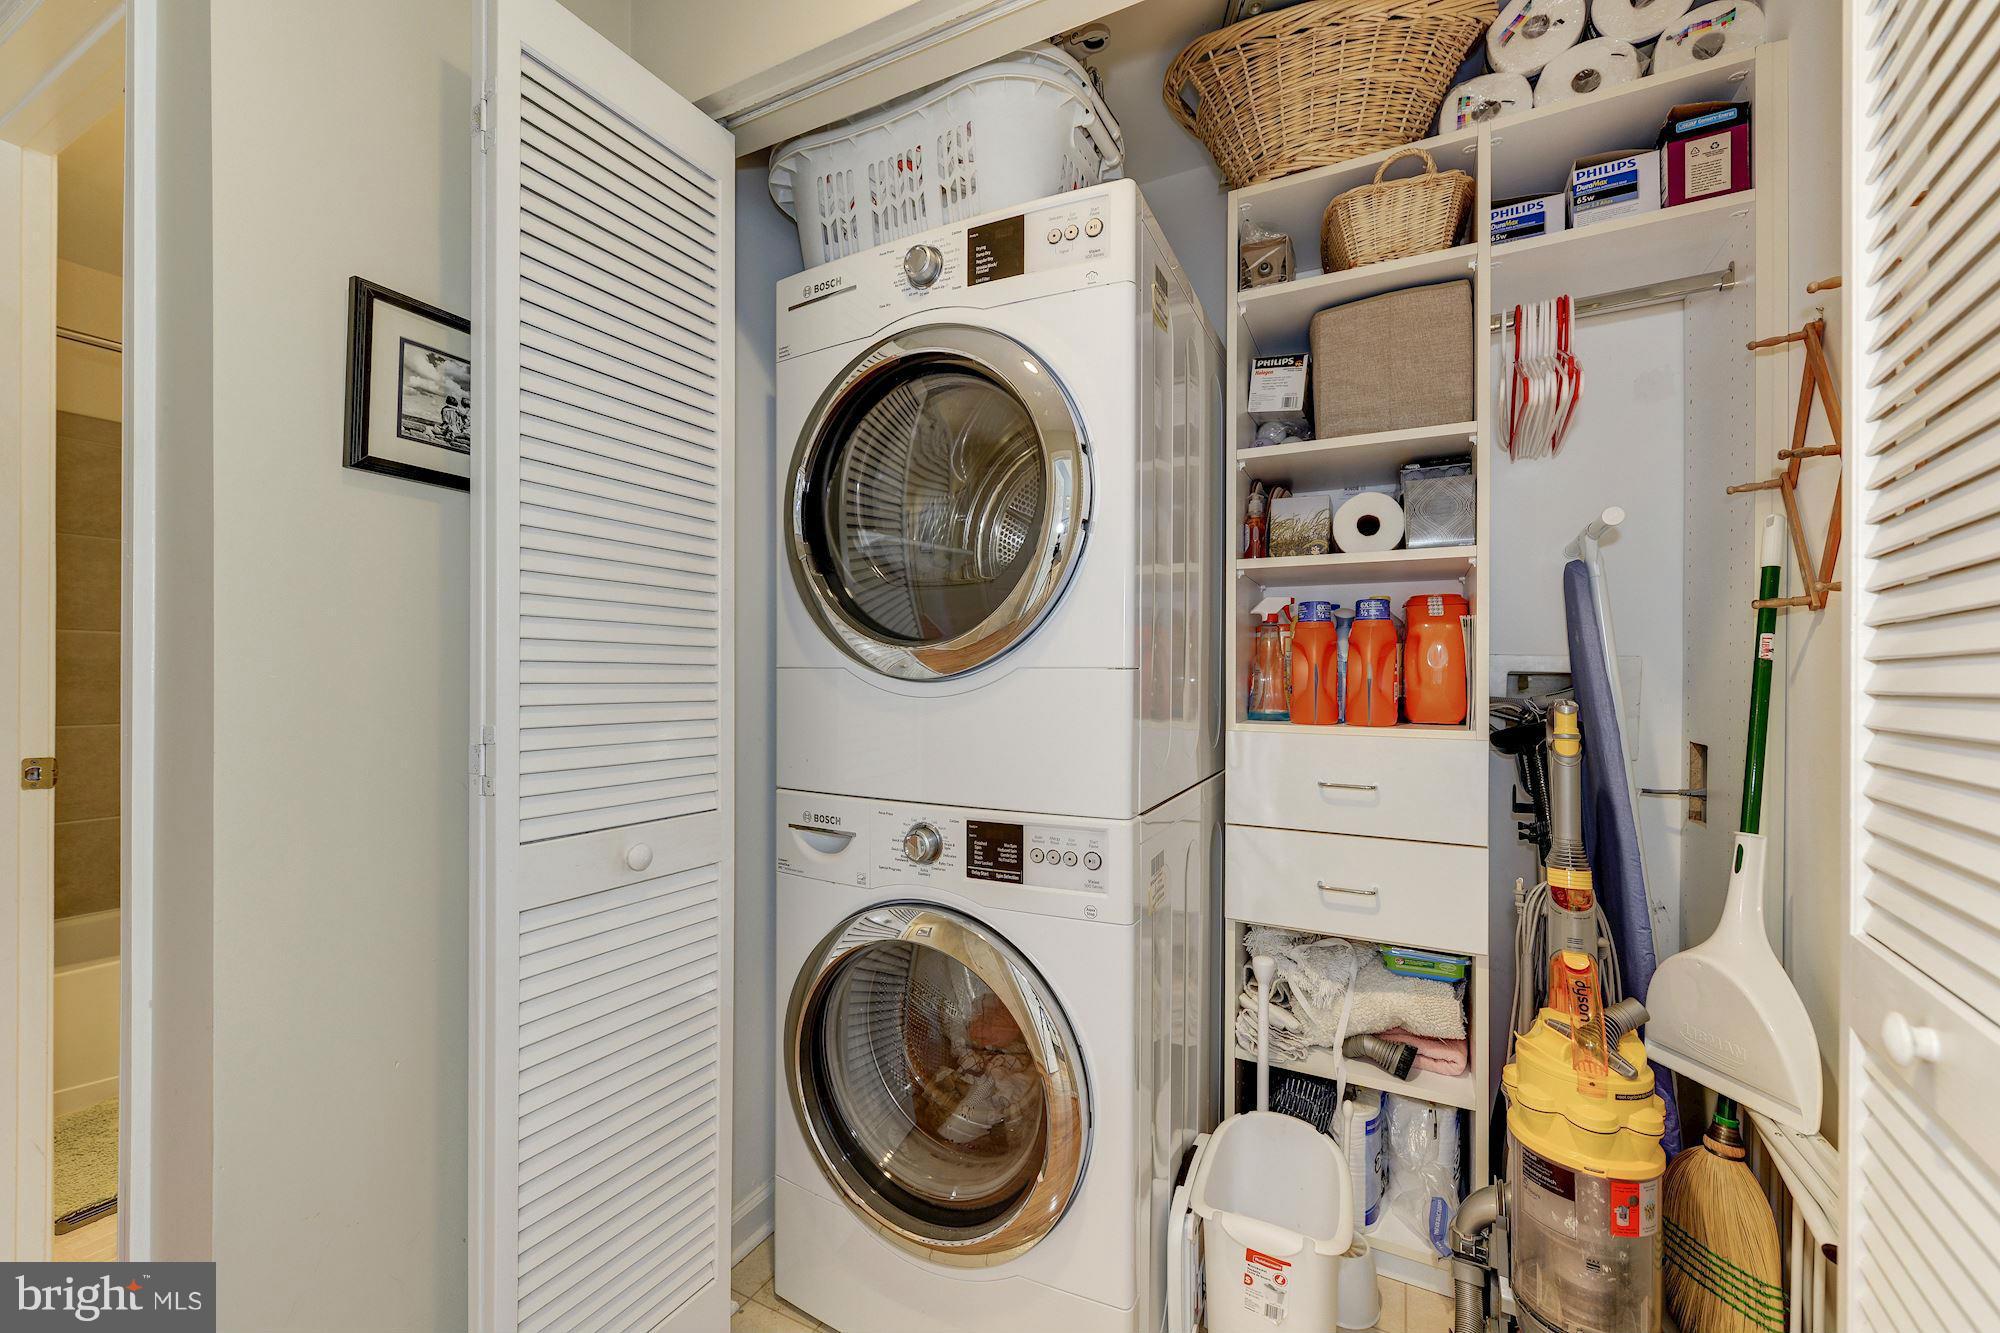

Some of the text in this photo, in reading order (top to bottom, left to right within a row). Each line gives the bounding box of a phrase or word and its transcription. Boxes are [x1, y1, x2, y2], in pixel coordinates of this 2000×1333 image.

[1576, 158, 1636, 181] PHILIPS
[1576, 179, 1608, 192] DuraMax
[1576, 195, 1595, 205] 65w
[1491, 200, 1544, 220] PHILIPS
[1491, 219, 1518, 231] DuraMax
[814, 276, 842, 294] BOSCH
[1257, 357, 1294, 368] PHILIPS
[813, 813, 842, 826] BOSCH
[1572, 980, 1591, 1023] dyson
